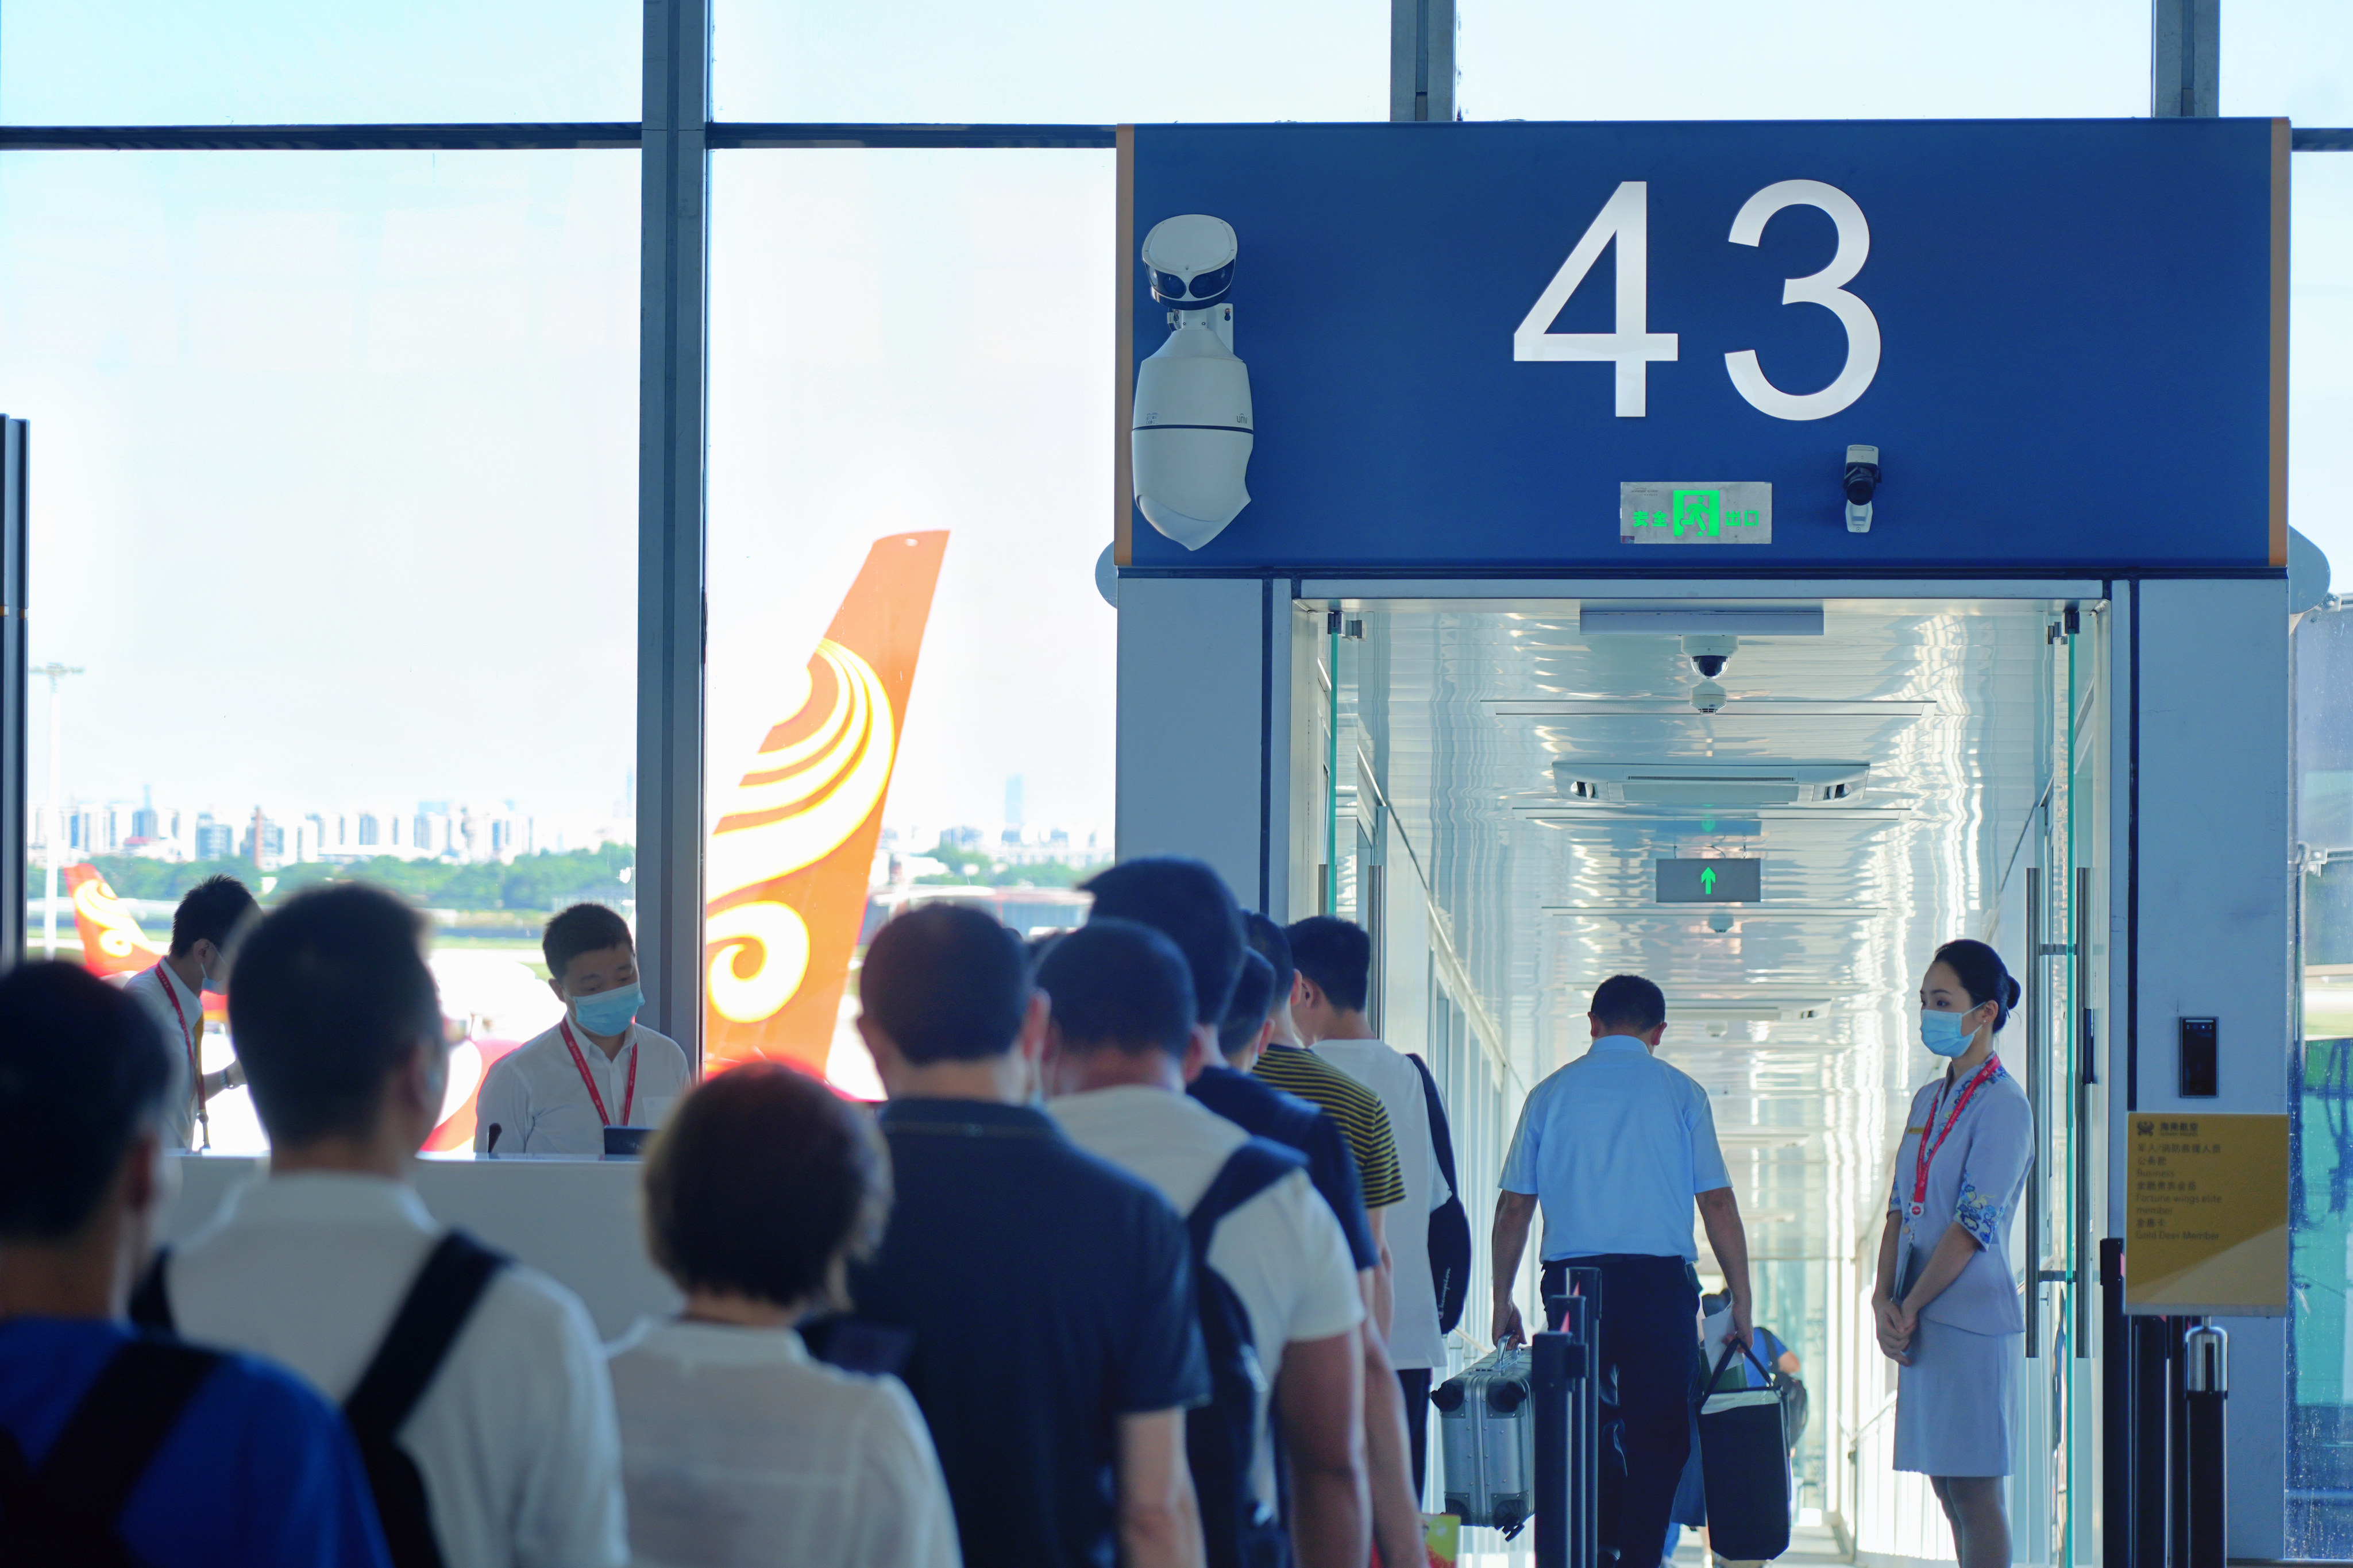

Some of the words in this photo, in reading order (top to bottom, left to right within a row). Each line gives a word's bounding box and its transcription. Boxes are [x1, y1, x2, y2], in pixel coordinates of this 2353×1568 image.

[1514, 179, 1881, 420] 43
[1633, 511, 1668, 527] 安全
[1725, 510, 1759, 526] 出口
[2137, 1168, 2174, 1177] Business
[2136, 1194, 2171, 1202] Fortune
[2173, 1195, 2200, 1204] wings
[2201, 1195, 2222, 1203] elite
[2136, 1207, 2172, 1215] member
[2136, 1231, 2157, 1239] Gold
[2159, 1230, 2180, 1239] Deer
[2182, 1231, 2219, 1239] Member
